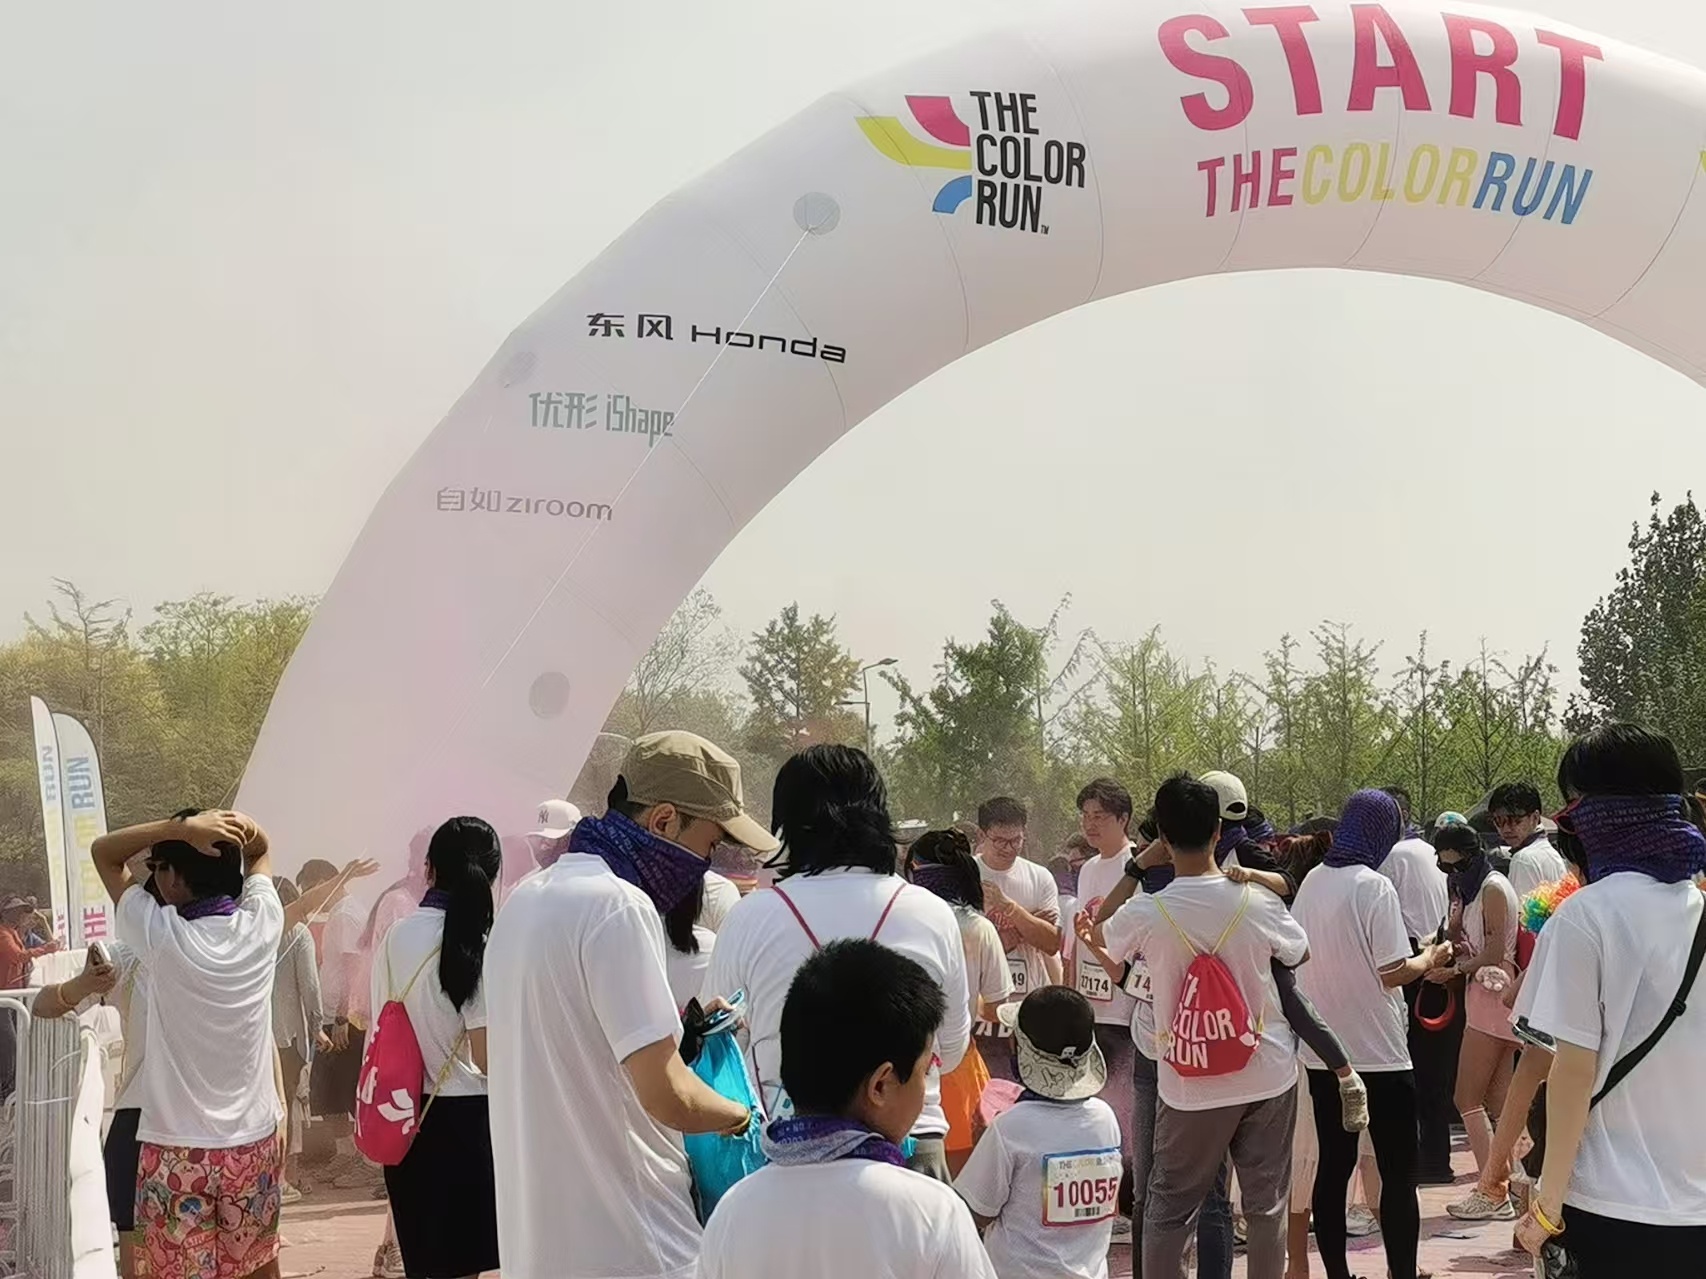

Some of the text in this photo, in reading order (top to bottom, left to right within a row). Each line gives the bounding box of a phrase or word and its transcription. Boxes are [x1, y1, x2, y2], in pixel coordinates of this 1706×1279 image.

[1158, 4, 1604, 141] START
[970, 91, 1039, 135] THE
[976, 133, 1086, 188] COLOR
[587, 313, 846, 363] 东风 Honda
[529, 392, 674, 448] 优形 iShape
[437, 487, 613, 521] 自如 ziroom
[66, 757, 96, 809] RUN
[1053, 1176, 1119, 1208] 10055
